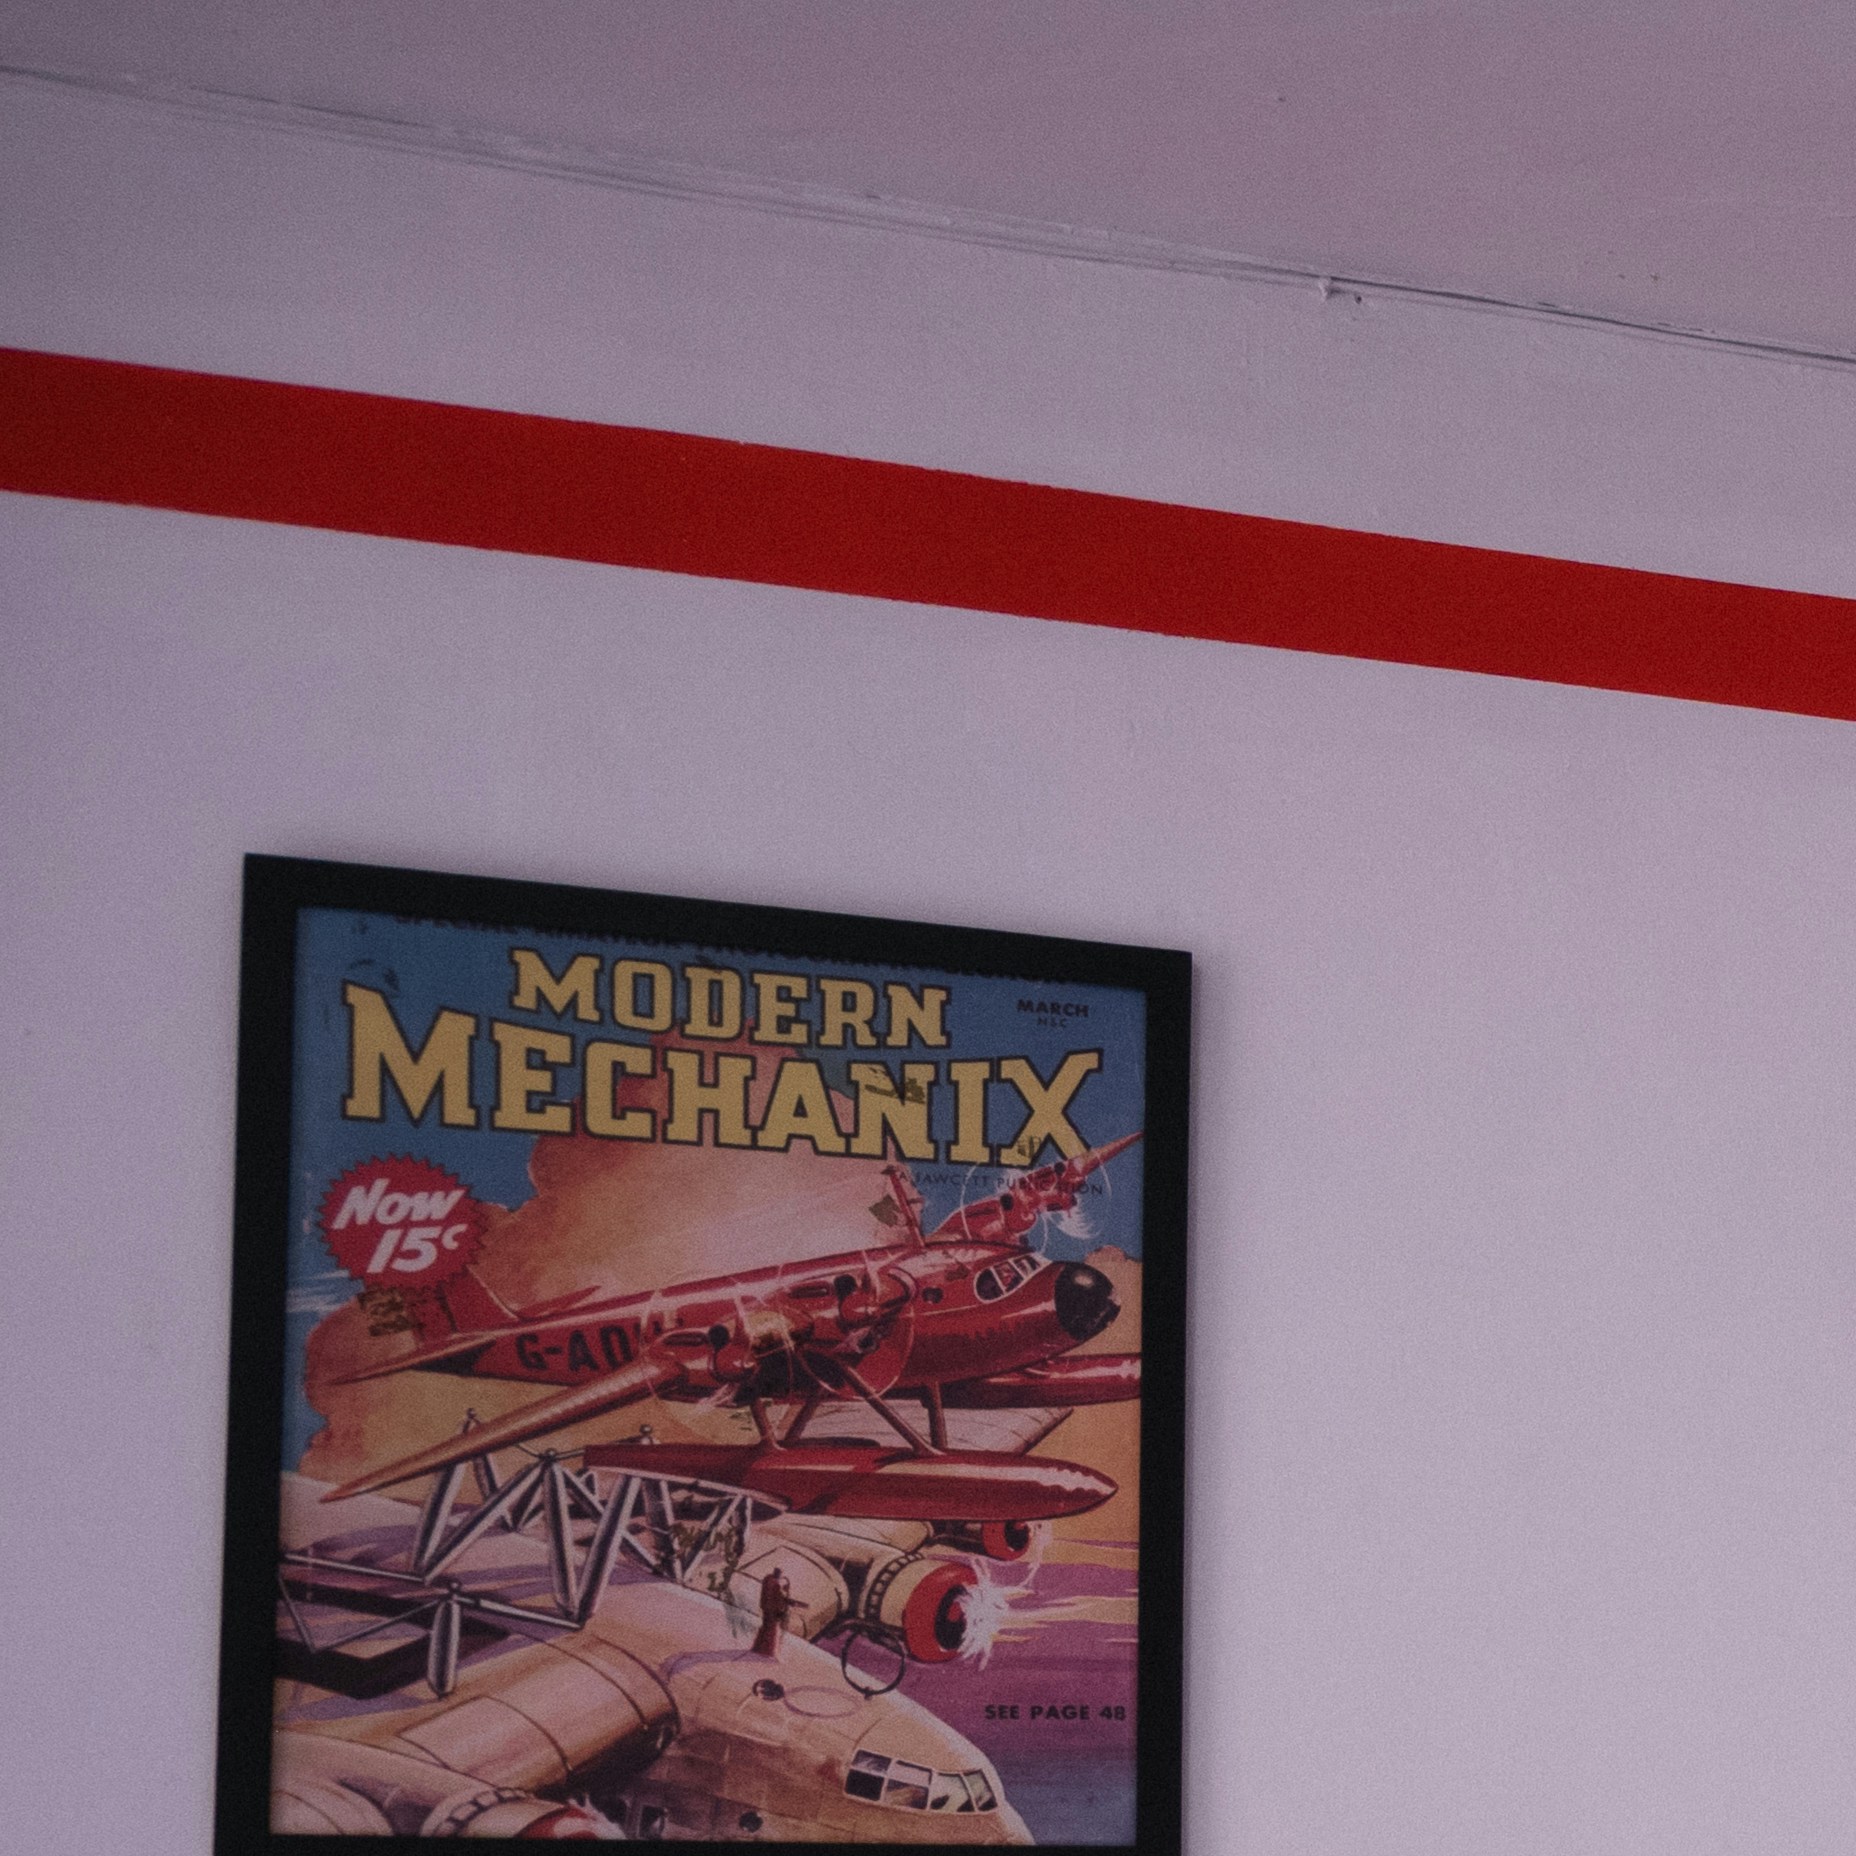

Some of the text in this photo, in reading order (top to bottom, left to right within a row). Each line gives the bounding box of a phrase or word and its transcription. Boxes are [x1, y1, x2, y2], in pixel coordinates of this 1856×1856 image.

[508, 947, 950, 1049] MODERN
[1016, 999, 1089, 1018] MARCH
[342, 981, 1103, 1168] MECHANIX
[984, 1704, 1126, 1721] SEE PAGE 48
